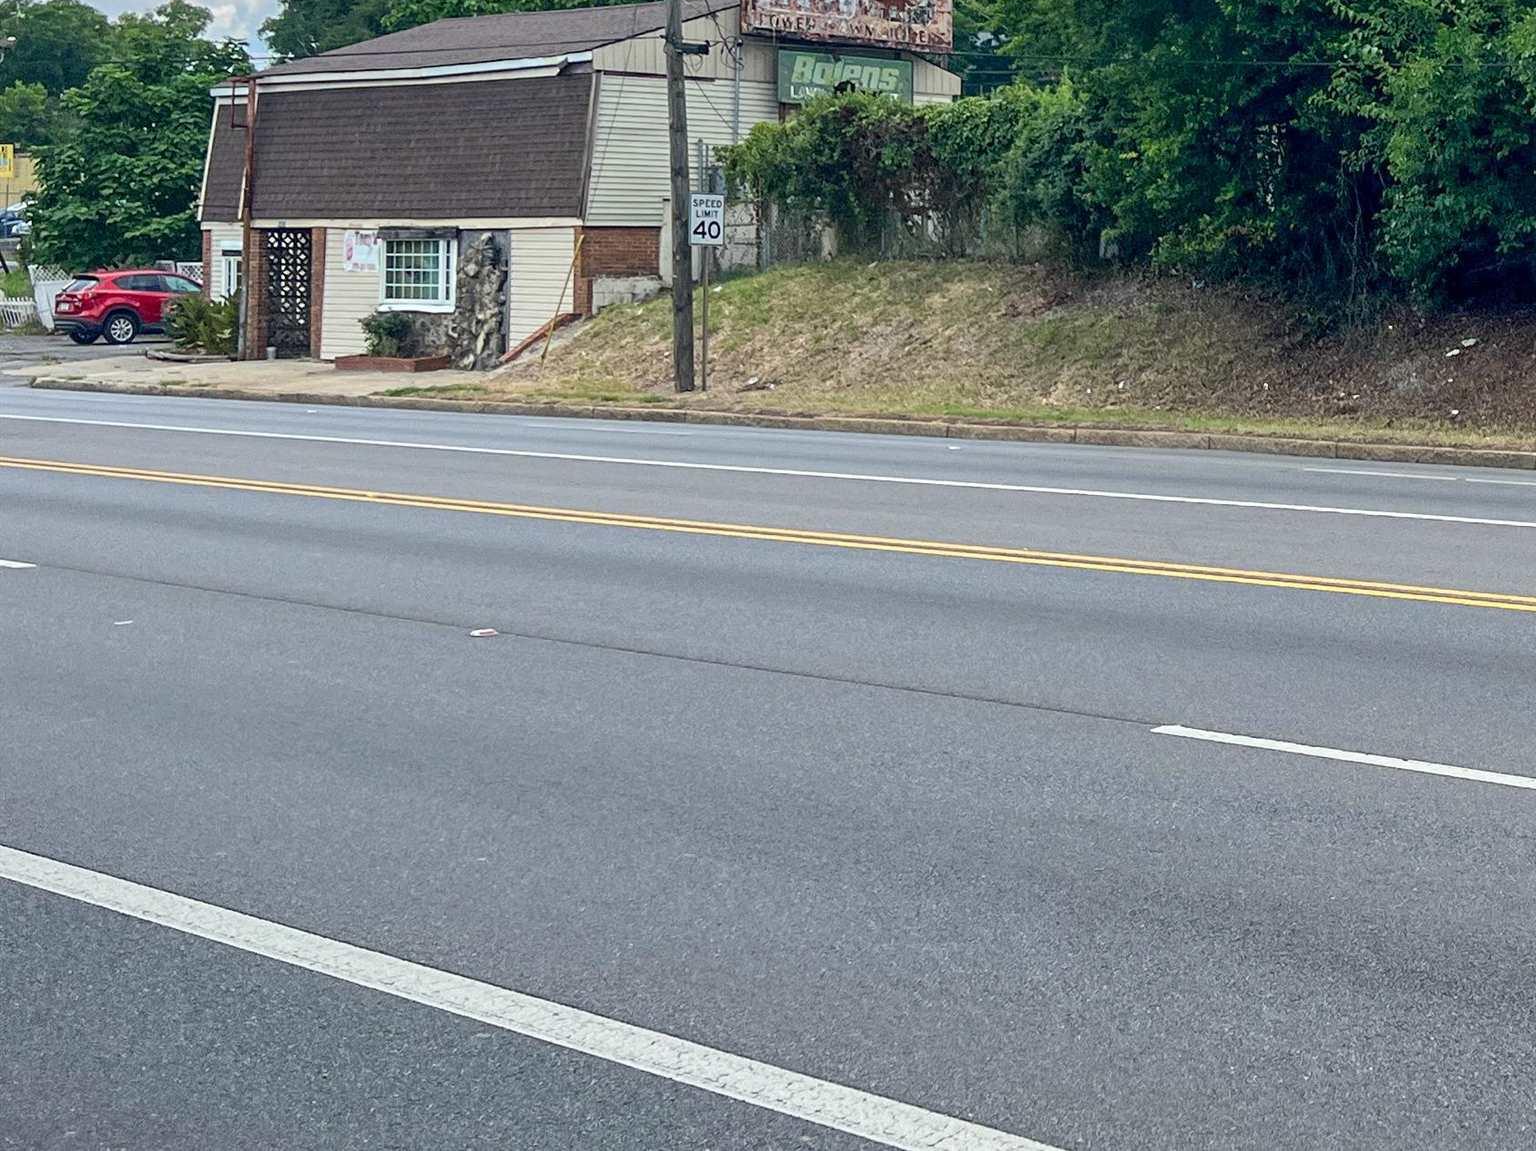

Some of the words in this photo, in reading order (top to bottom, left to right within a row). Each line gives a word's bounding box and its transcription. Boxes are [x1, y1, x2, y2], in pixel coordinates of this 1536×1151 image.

[791, 55, 900, 92] Bolens
[693, 199, 723, 208] SPEED
[696, 210, 719, 218] LIMIT
[693, 221, 721, 239] 40
